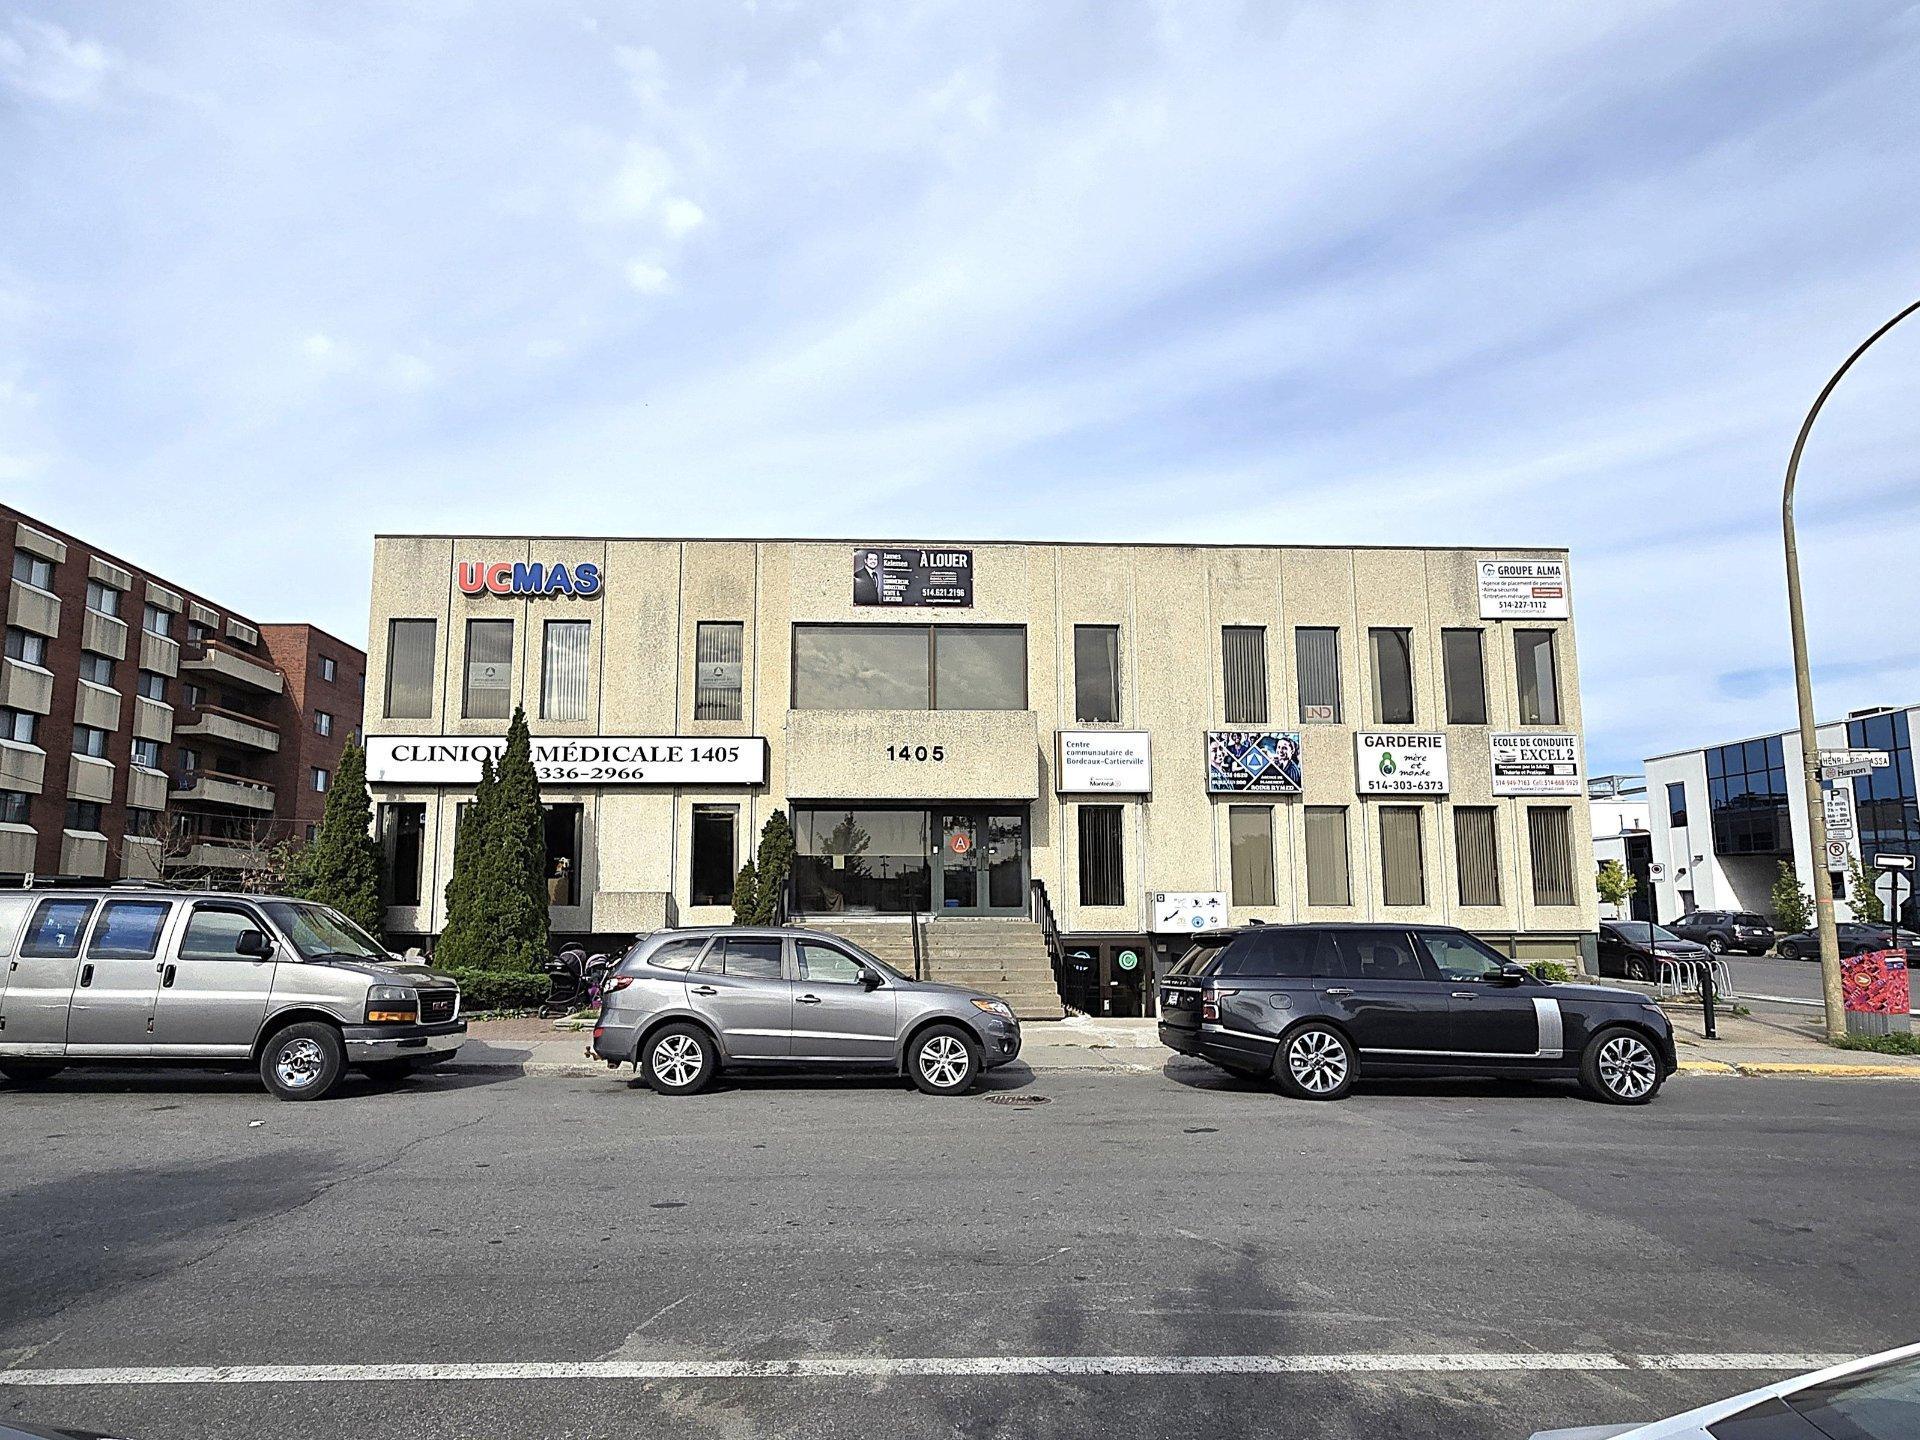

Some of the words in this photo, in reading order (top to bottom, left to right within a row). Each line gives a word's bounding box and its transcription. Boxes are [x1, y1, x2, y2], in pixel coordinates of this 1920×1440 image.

[920, 551, 928, 567] À
[930, 554, 967, 568] LOUER
[1498, 566, 1532, 575] GROUPE
[1537, 566, 1561, 575] ALMA
[458, 562, 601, 595] UCMAS
[1365, 736, 1442, 748] GARDERIE
[1493, 737, 1517, 746] ÉCOLE
[1520, 738, 1530, 746] DE
[1532, 738, 1574, 746] CONDUITE
[391, 745, 502, 762] CLINIQU
[535, 742, 683, 762] MÉDICALE
[690, 746, 739, 762] 1405
[886, 746, 944, 761] 1405
[1520, 749, 1565, 760] EXCEL
[1567, 749, 1574, 760] 2
[1838, 768, 1866, 776] Hamon
[1368, 781, 1443, 790] 514-303-6373
[1831, 790, 1840, 800] P
